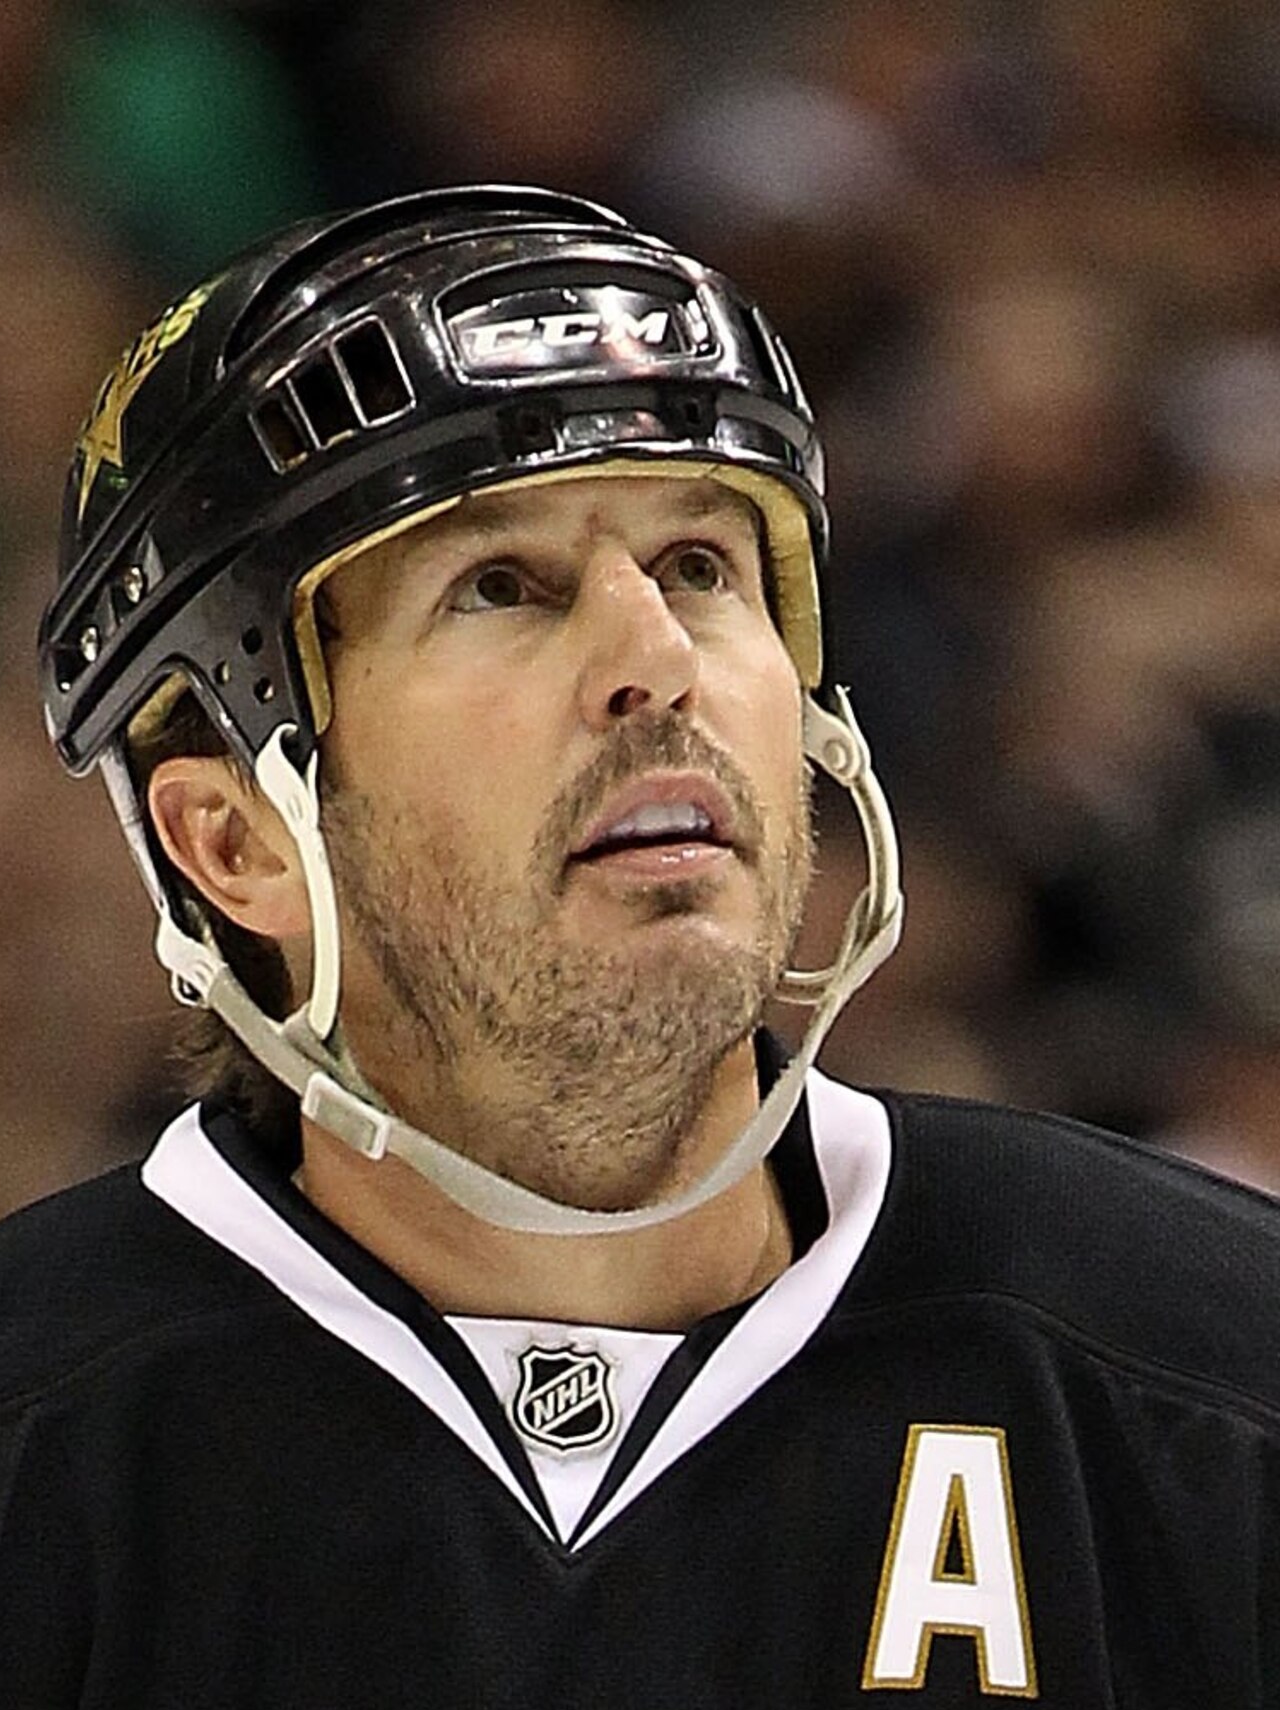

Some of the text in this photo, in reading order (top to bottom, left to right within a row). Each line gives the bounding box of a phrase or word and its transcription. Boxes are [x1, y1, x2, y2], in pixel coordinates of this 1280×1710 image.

[456, 310, 669, 355] CCM
[532, 1368, 599, 1430] NHL
[861, 1423, 1038, 1698] A
